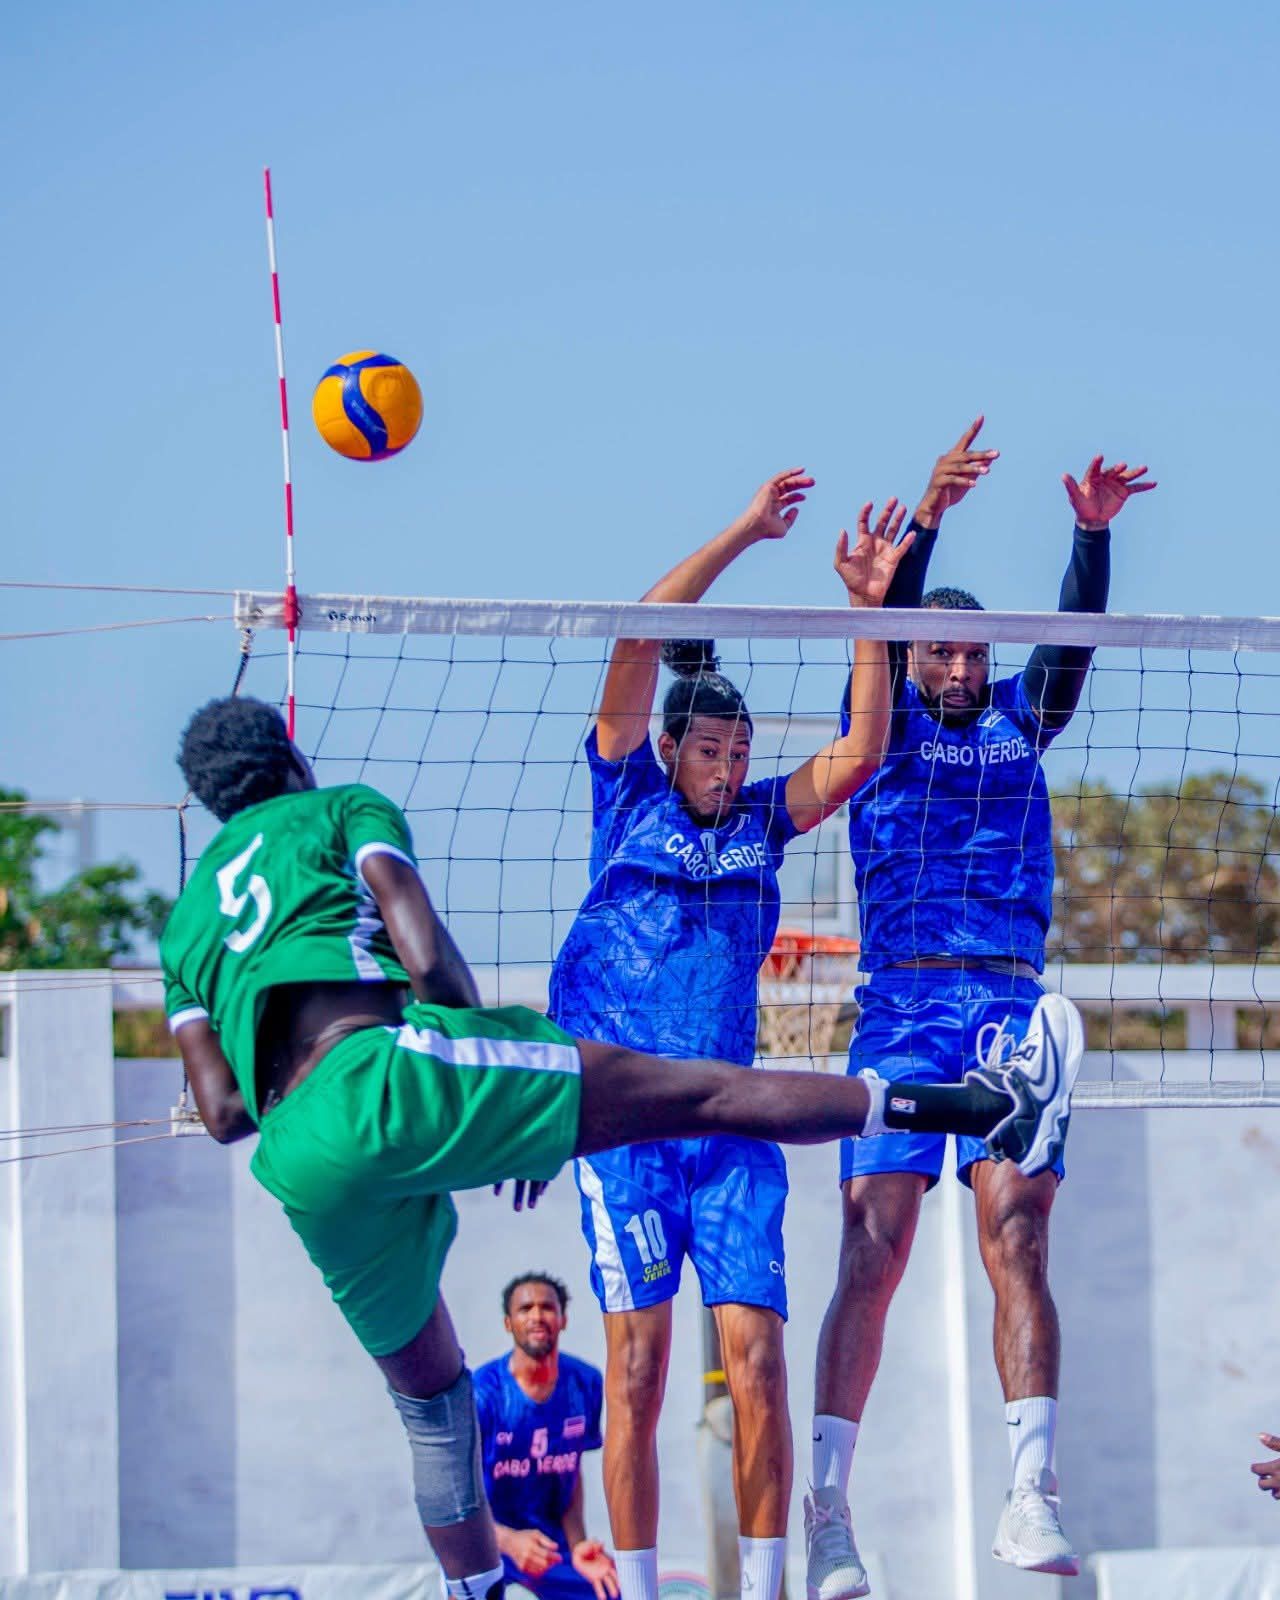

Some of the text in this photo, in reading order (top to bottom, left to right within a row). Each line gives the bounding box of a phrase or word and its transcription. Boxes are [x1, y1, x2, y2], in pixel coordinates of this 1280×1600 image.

[920, 735, 1029, 766] CABO VERDE
[665, 833, 709, 879] CABO
[216, 832, 272, 953] 5
[624, 1208, 667, 1264] 10
[642, 1266, 672, 1283] VERDE
[644, 1259, 669, 1275] CABO
[530, 1427, 548, 1459] 5
[493, 1458, 530, 1479] CABO
